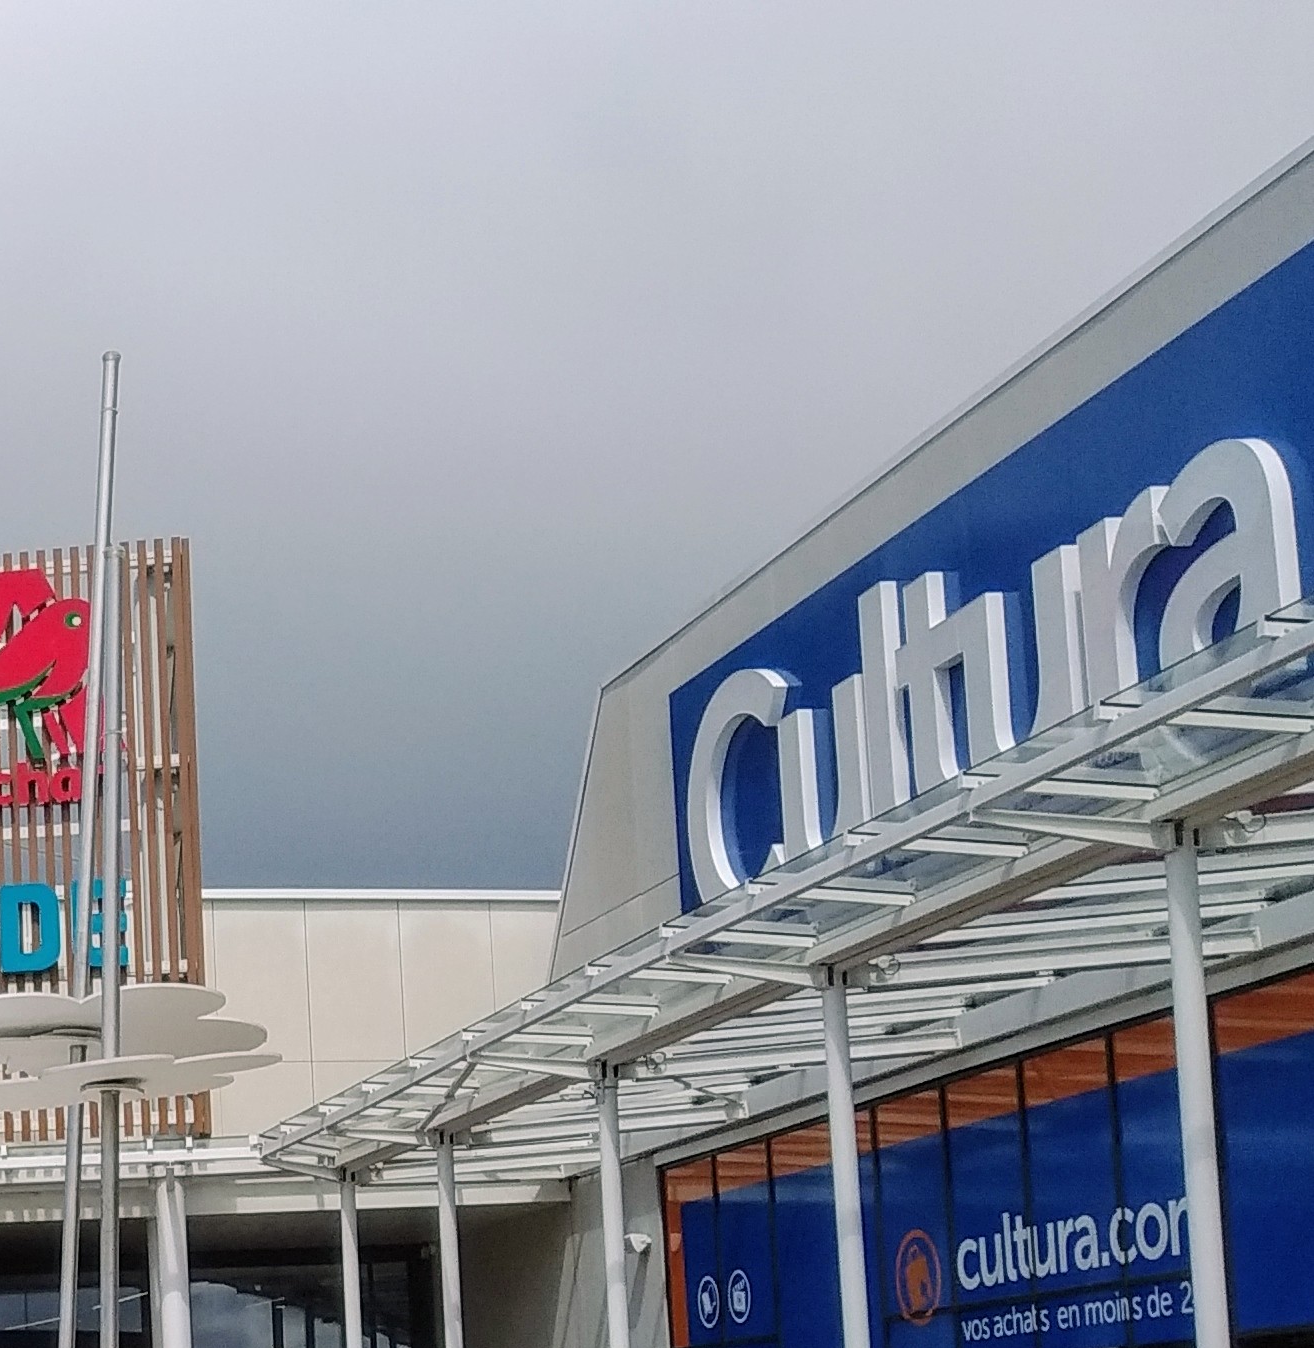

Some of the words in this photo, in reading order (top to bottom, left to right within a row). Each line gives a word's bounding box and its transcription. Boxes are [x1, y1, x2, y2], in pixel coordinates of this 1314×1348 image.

[689, 438, 1301, 902] Cultura
[961, 1316, 990, 1341] vos
[993, 1304, 1050, 1338] achats
[1057, 1308, 1080, 1330] en
[1085, 1292, 1142, 1326] moins
[1147, 1285, 1173, 1318] de
